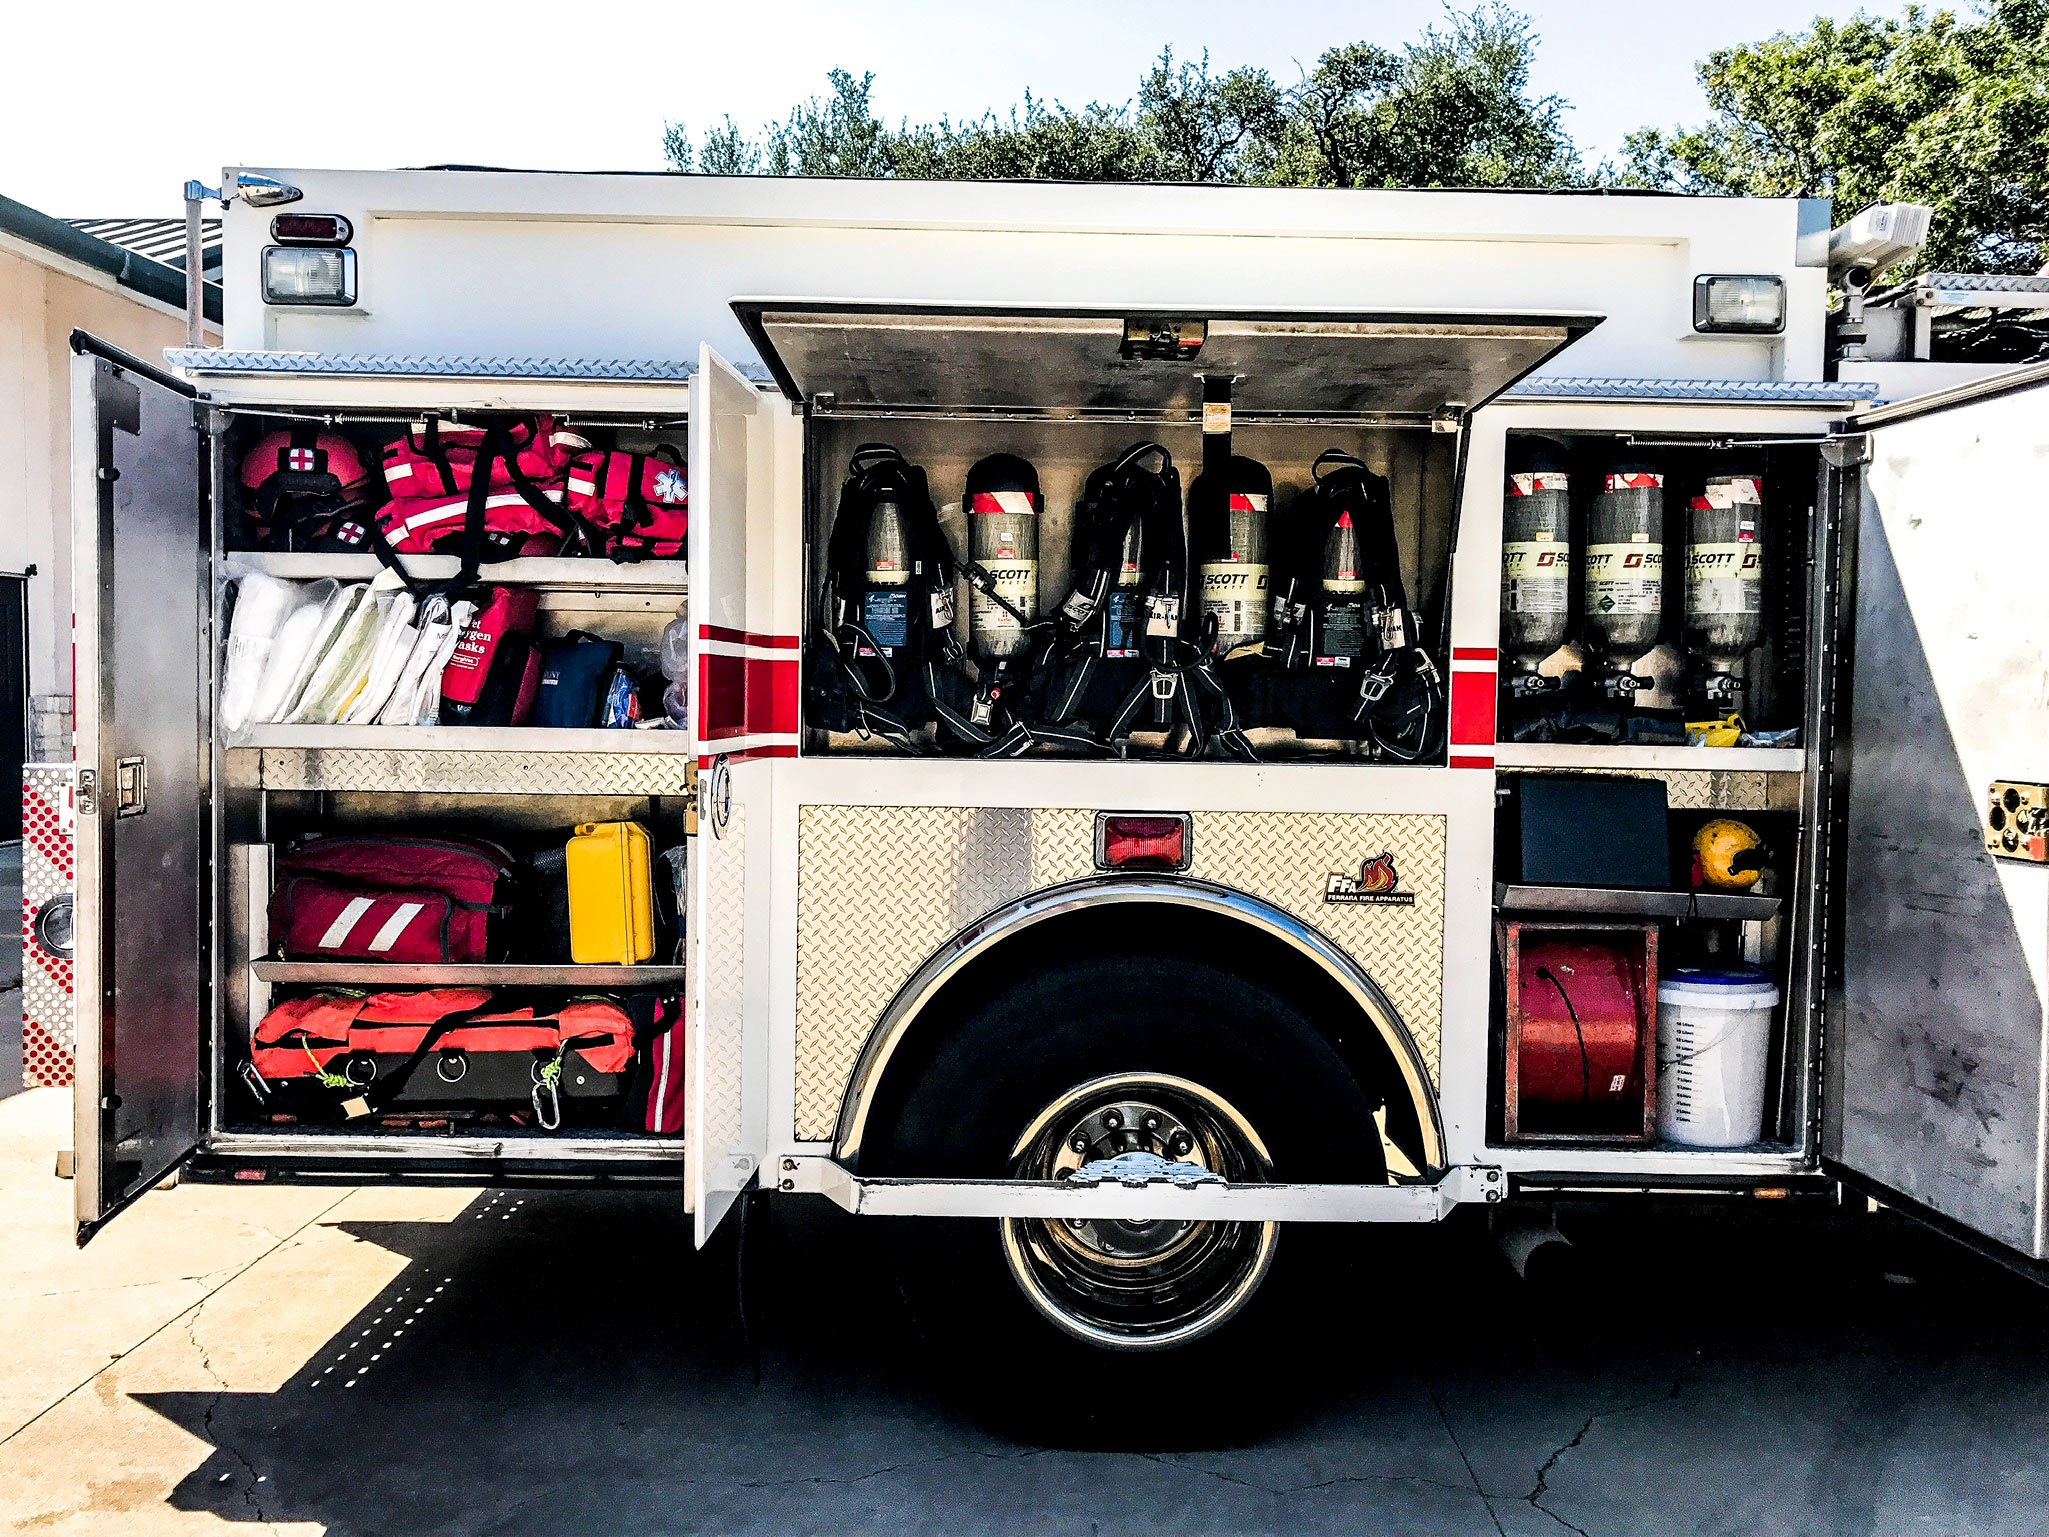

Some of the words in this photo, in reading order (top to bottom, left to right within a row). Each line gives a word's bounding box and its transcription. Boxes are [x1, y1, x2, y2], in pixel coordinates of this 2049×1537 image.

[1503, 552, 1527, 562] OTT
[1645, 553, 1663, 564] SCO
[1692, 553, 1735, 565] SCOTT
[990, 569, 1031, 580] SCOTT
[1206, 573, 1249, 585] SCOTT
[471, 619, 482, 629] et
[463, 630, 492, 642] ygen
[457, 641, 486, 654] asks
[1327, 894, 1358, 902] FERRARA
